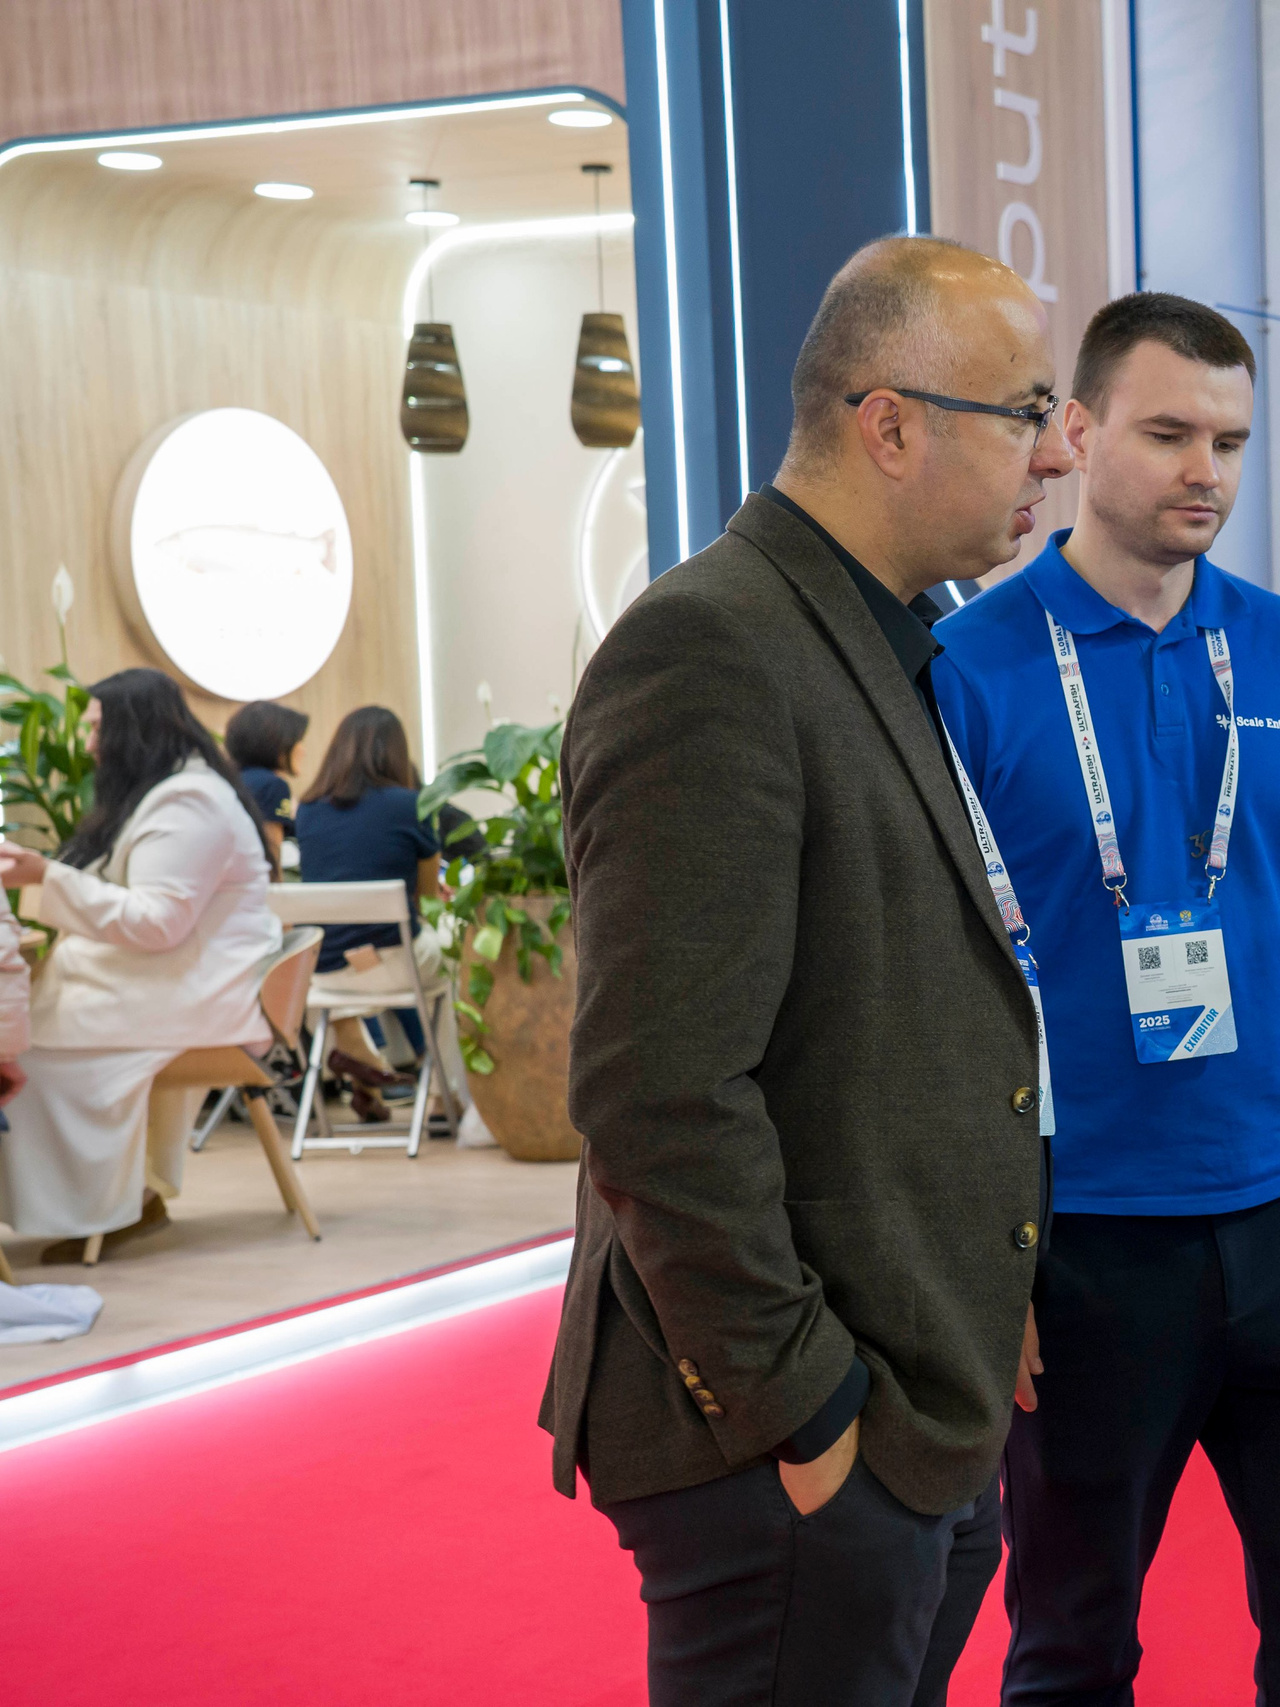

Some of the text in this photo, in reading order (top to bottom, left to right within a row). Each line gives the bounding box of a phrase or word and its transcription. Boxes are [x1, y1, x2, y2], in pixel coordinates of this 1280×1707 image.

[1055, 626, 1067, 657] GLOBAL
[1070, 684, 1086, 732] ULTRAFISH
[1236, 716, 1264, 727] Scale
[1086, 754, 1102, 804] ULTRAFISH
[1226, 748, 1236, 798] ULTRAFISH
[969, 797, 990, 854] ULTRAFISH
[1139, 1015, 1171, 1028] 2025
[1184, 1008, 1219, 1052] EXHIBITOR
